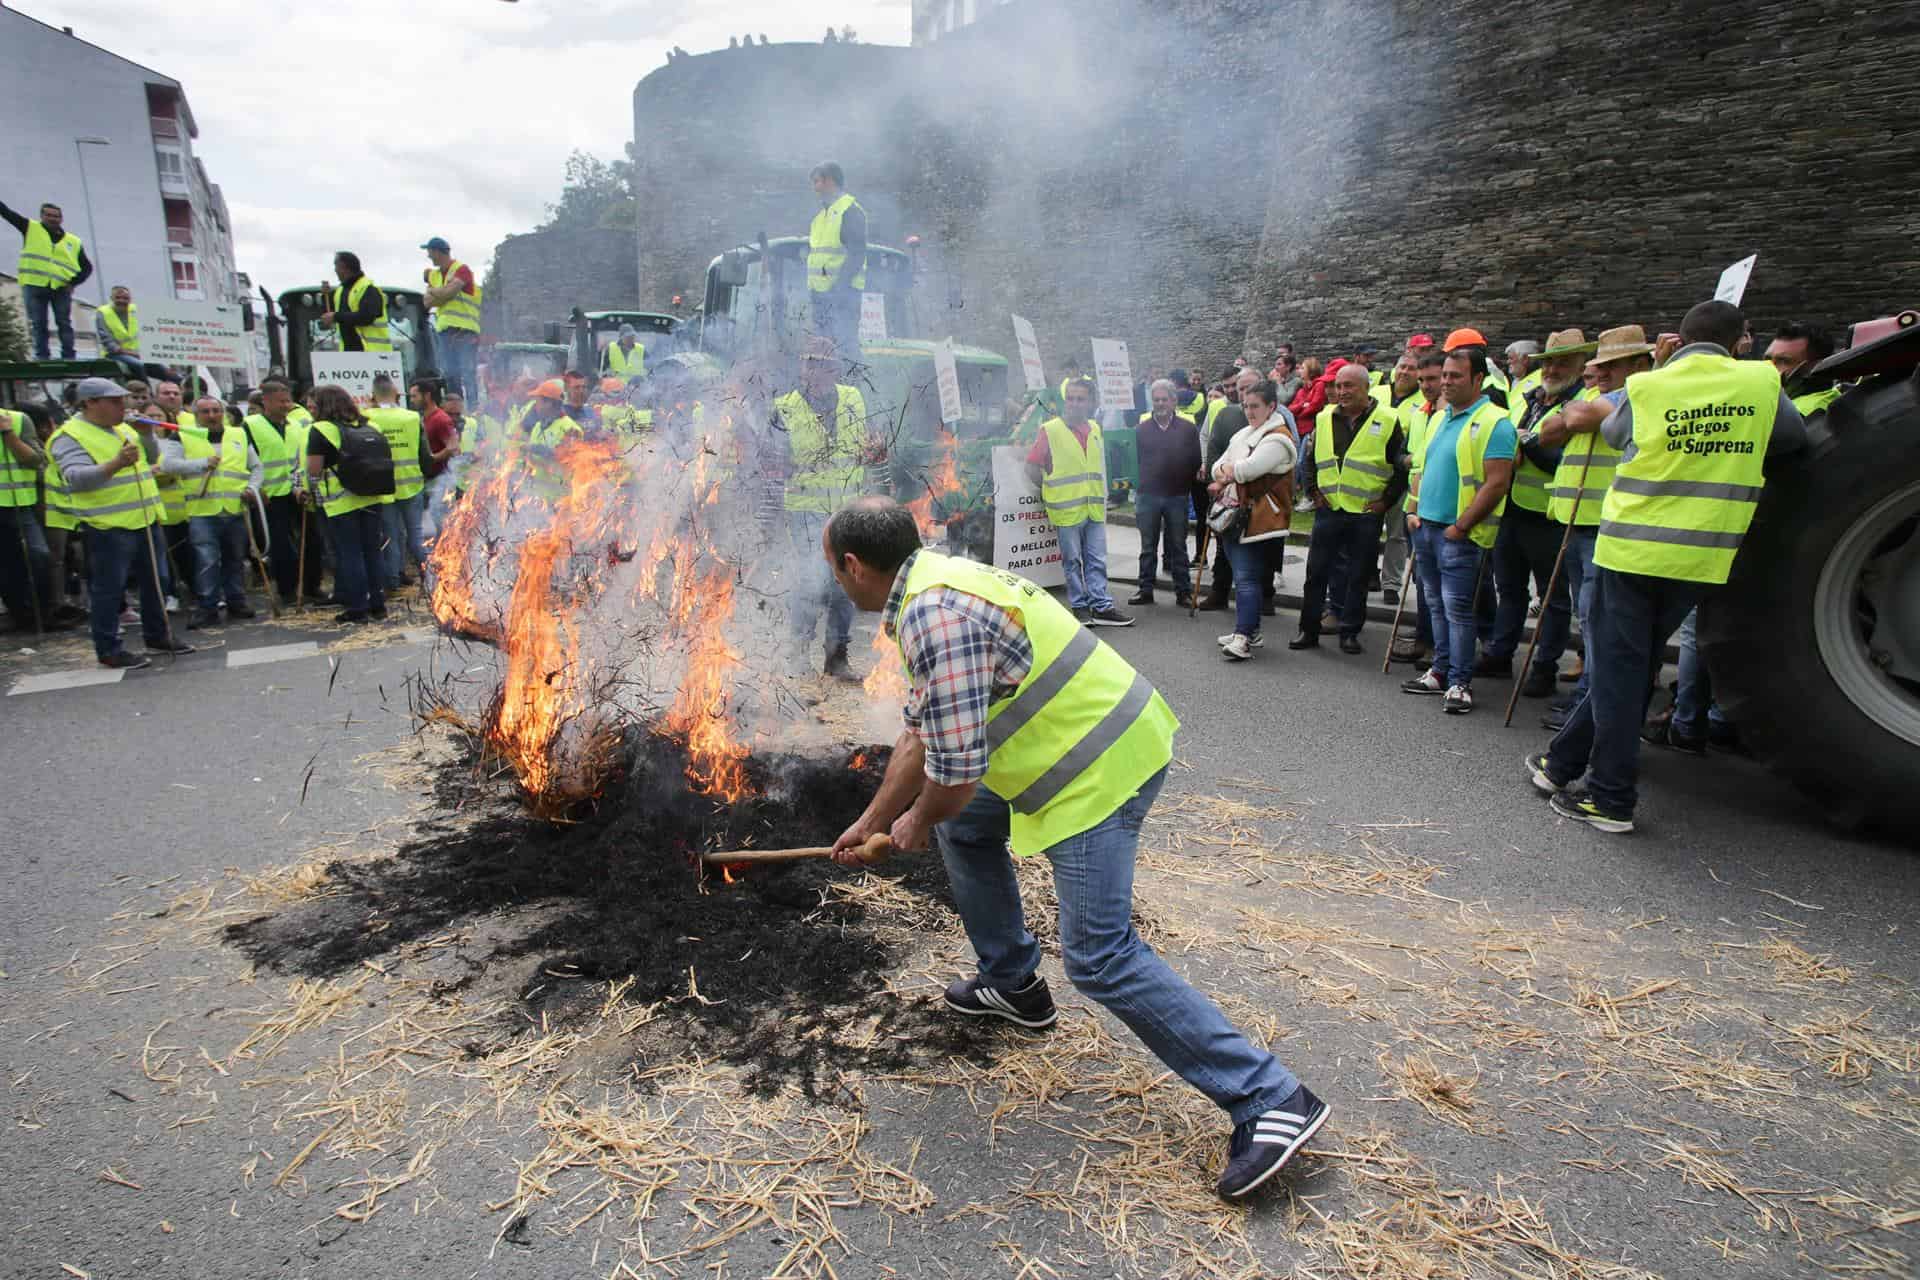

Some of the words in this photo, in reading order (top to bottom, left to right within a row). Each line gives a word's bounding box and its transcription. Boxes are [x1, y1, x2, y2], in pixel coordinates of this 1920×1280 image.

[318, 370, 327, 379] A
[332, 370, 369, 379] NOVA
[1664, 402, 1755, 422] Gandeiros
[1666, 421, 1730, 437] Galegos
[1002, 513, 1015, 522] OS
[1029, 526, 1036, 535] E
[1038, 525, 1045, 533] O
[1011, 545, 1018, 553] O
[1021, 538, 1057, 552] MELLOR
[1008, 557, 1033, 569] PARA
[1035, 556, 1042, 565] O
